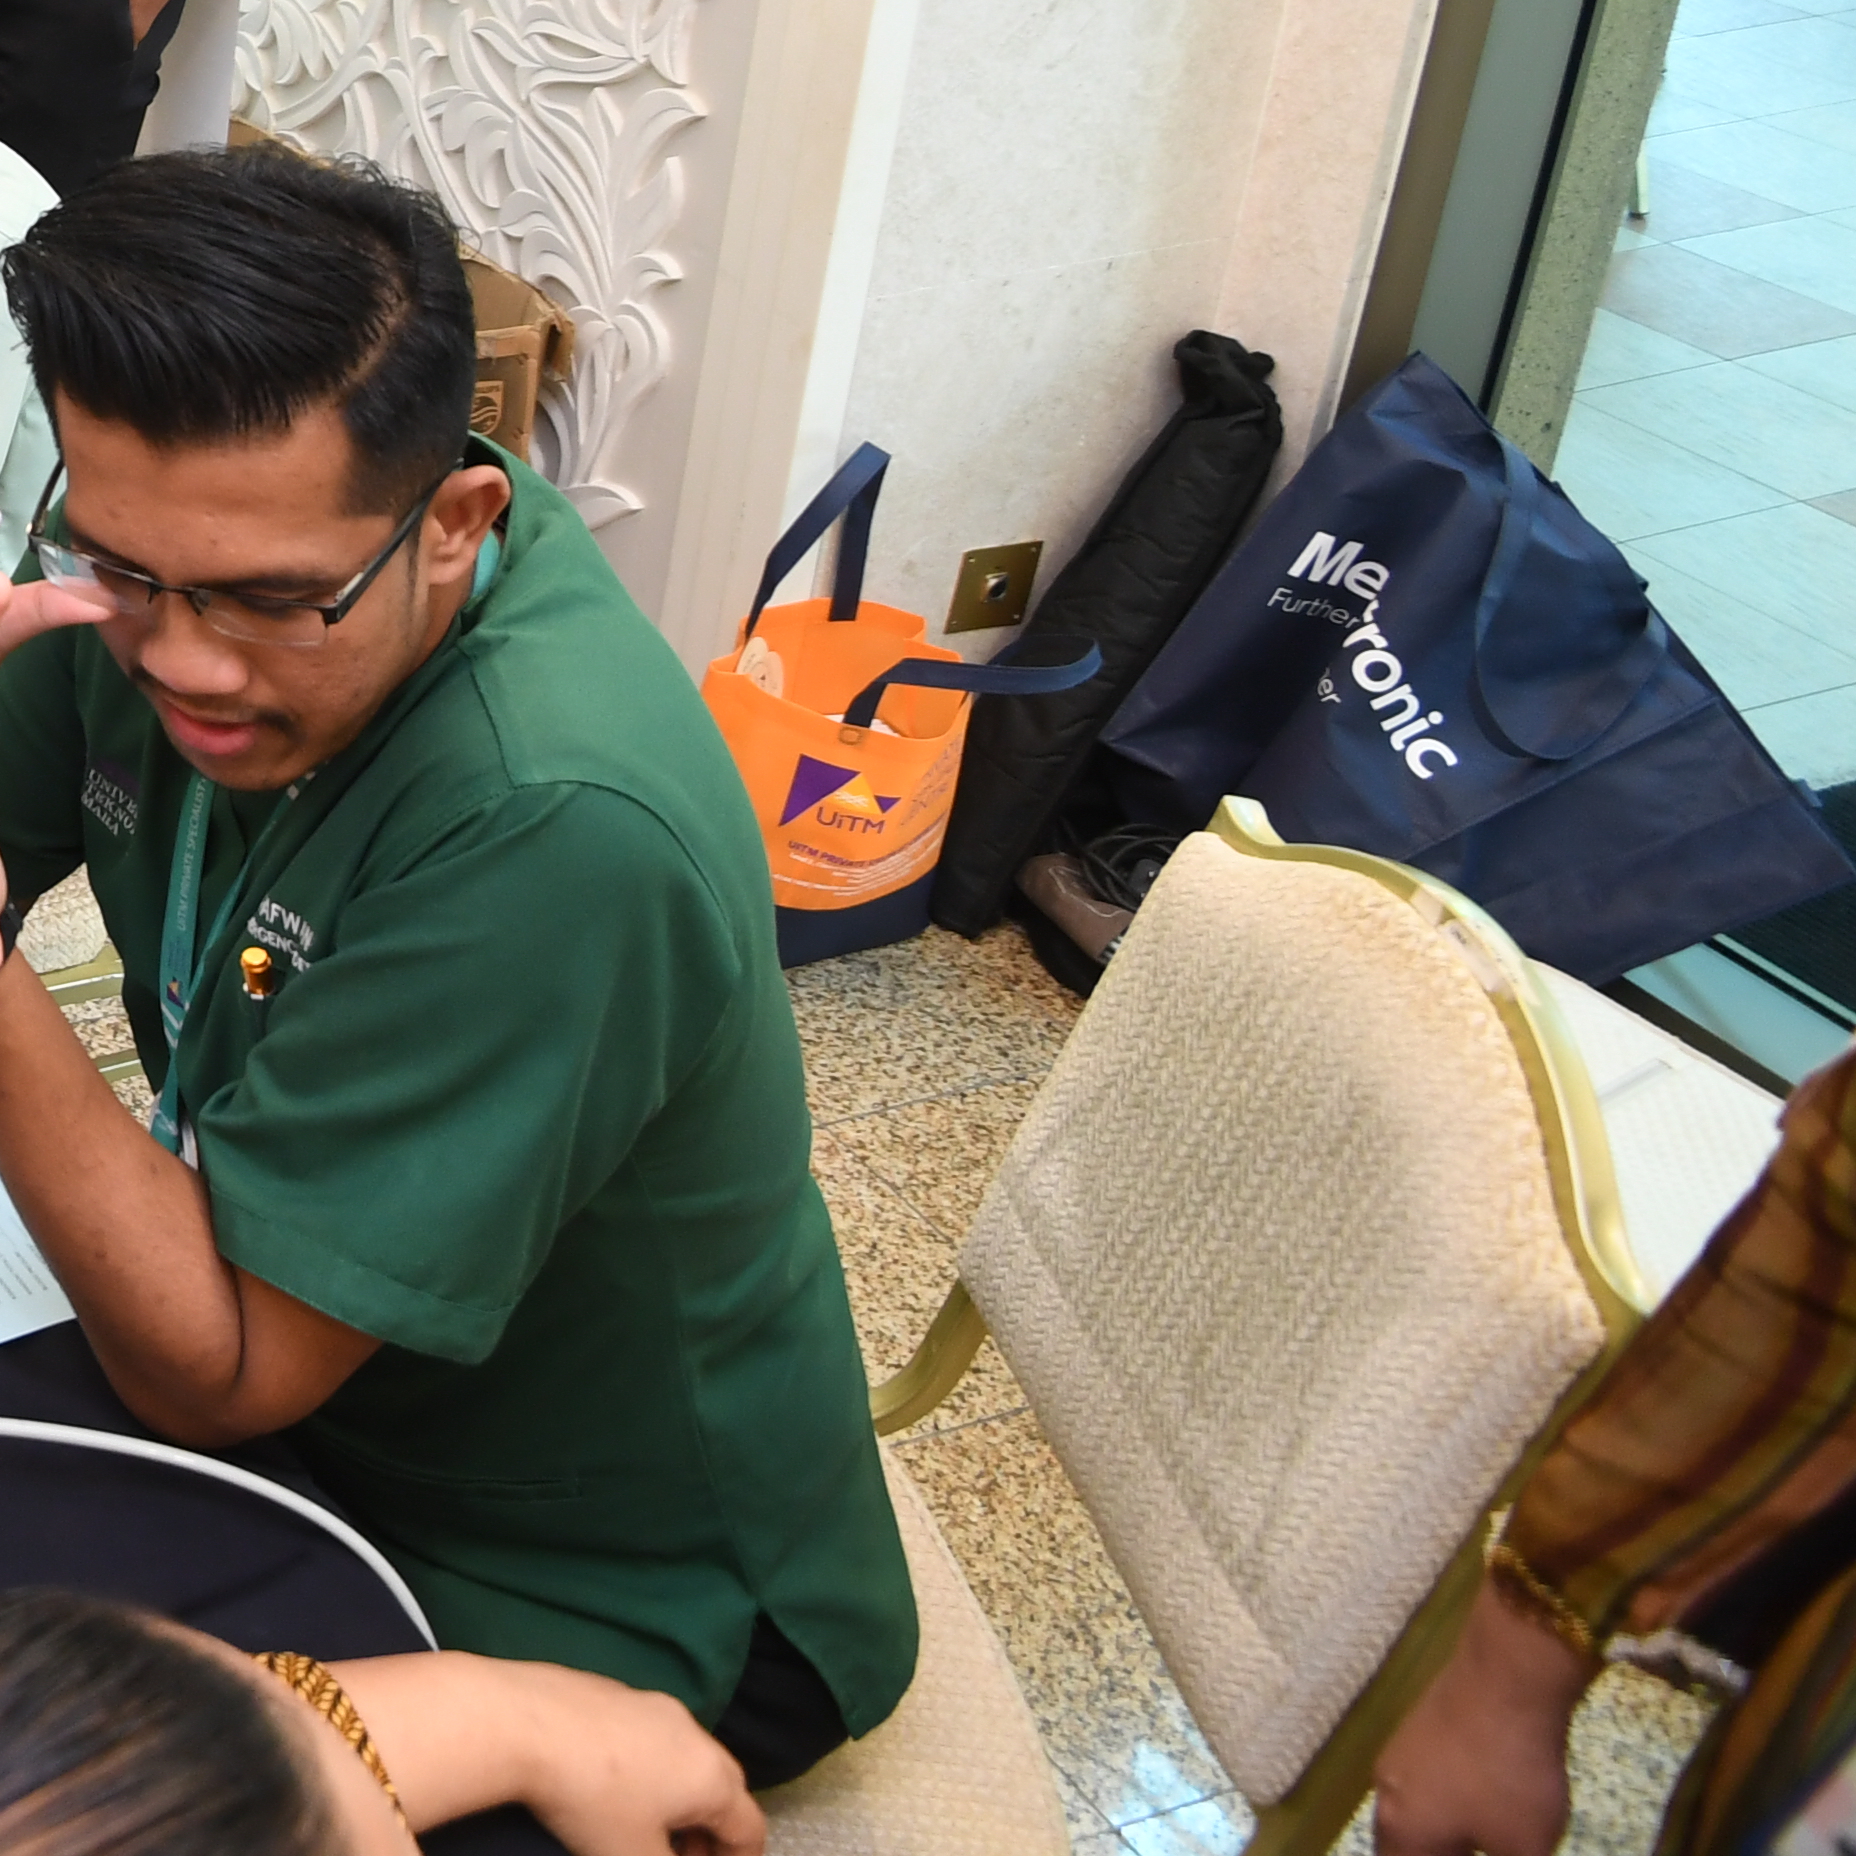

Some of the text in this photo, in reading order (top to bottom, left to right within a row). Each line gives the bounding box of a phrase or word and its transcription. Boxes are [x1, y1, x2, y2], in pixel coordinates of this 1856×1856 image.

[179, 851, 195, 897] PRIVATE
[187, 783, 207, 850] SPECIALIST
[816, 805, 886, 835] UiTM
